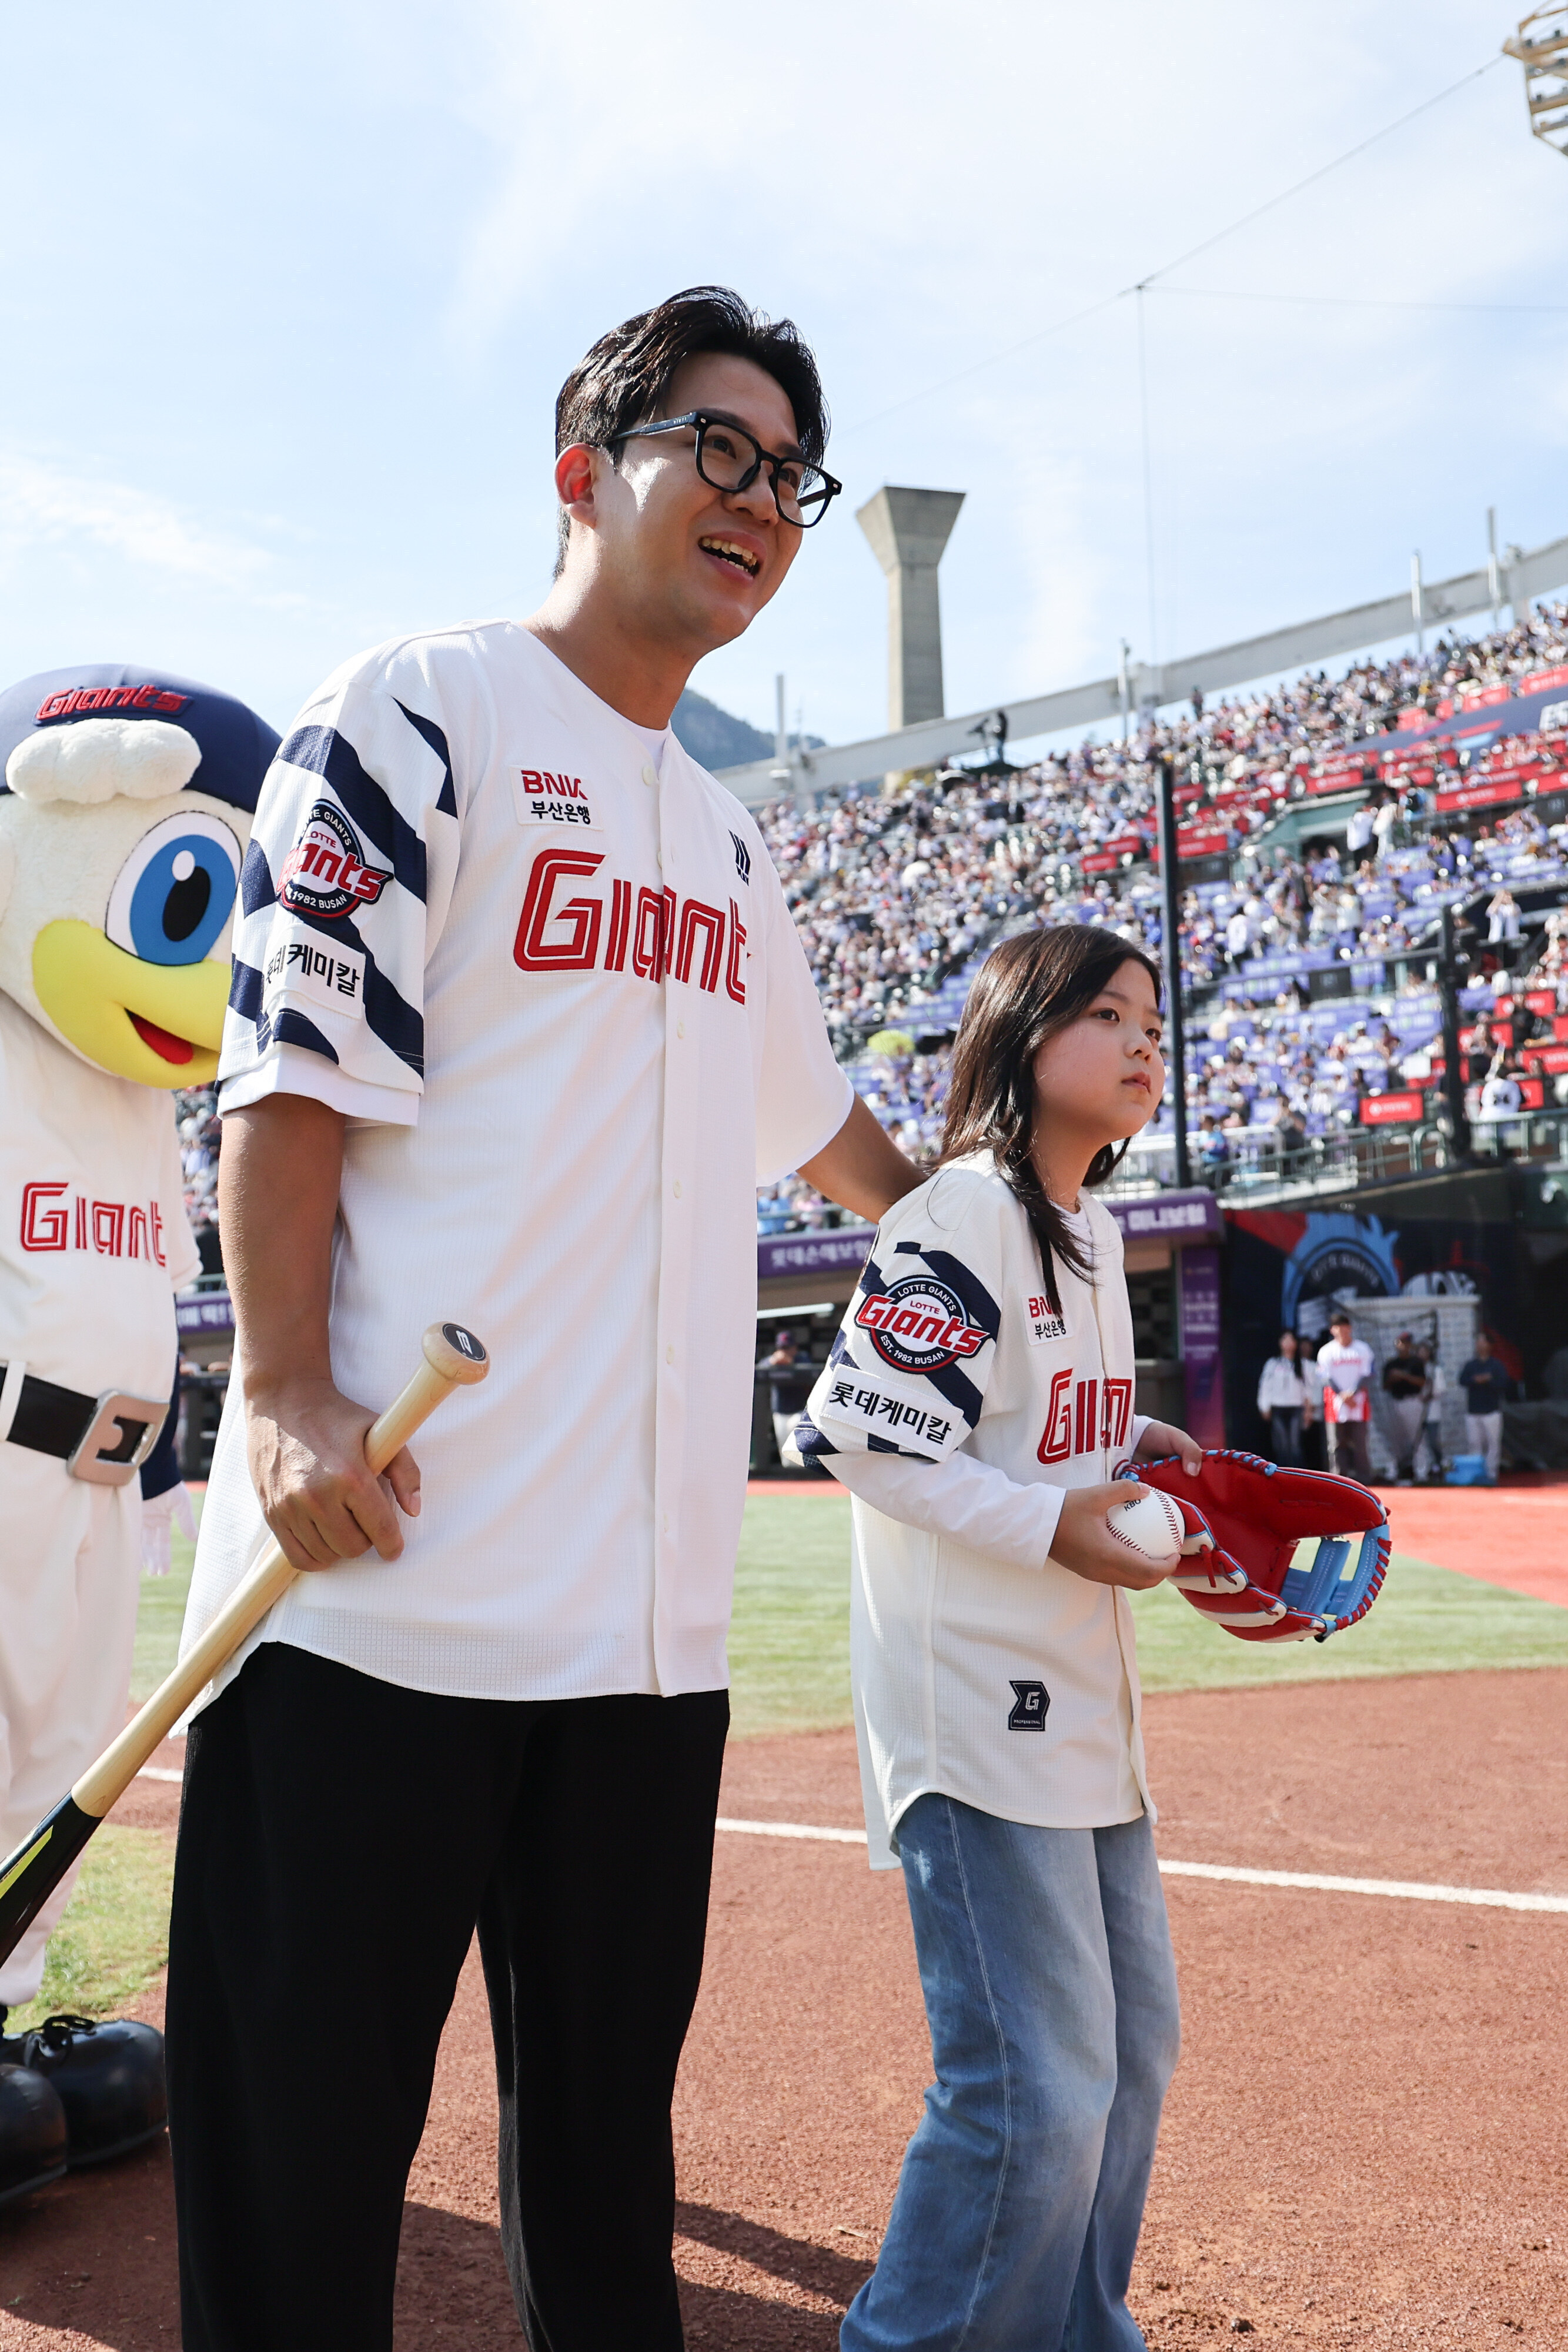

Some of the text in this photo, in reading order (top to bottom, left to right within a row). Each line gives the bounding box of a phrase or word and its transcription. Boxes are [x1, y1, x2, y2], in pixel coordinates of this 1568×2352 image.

[521, 770, 589, 800] BNK
[531, 801, 591, 824] 부산은행
[324, 811, 352, 846] GIANTS
[292, 891, 316, 906] 1982
[318, 894, 347, 909] BUSAN
[513, 848, 751, 1005] Giant
[898, 1284, 956, 1311] LOTTE GIANTS
[910, 1301, 940, 1314] LOTTE
[1029, 1296, 1052, 1318] BN
[1035, 1319, 1066, 1339] 부산은행
[881, 1335, 945, 1364] EST. 1982 BUSAN
[829, 1381, 952, 1445] 롯데케미칼
[1124, 1499, 1141, 1512] KBO
